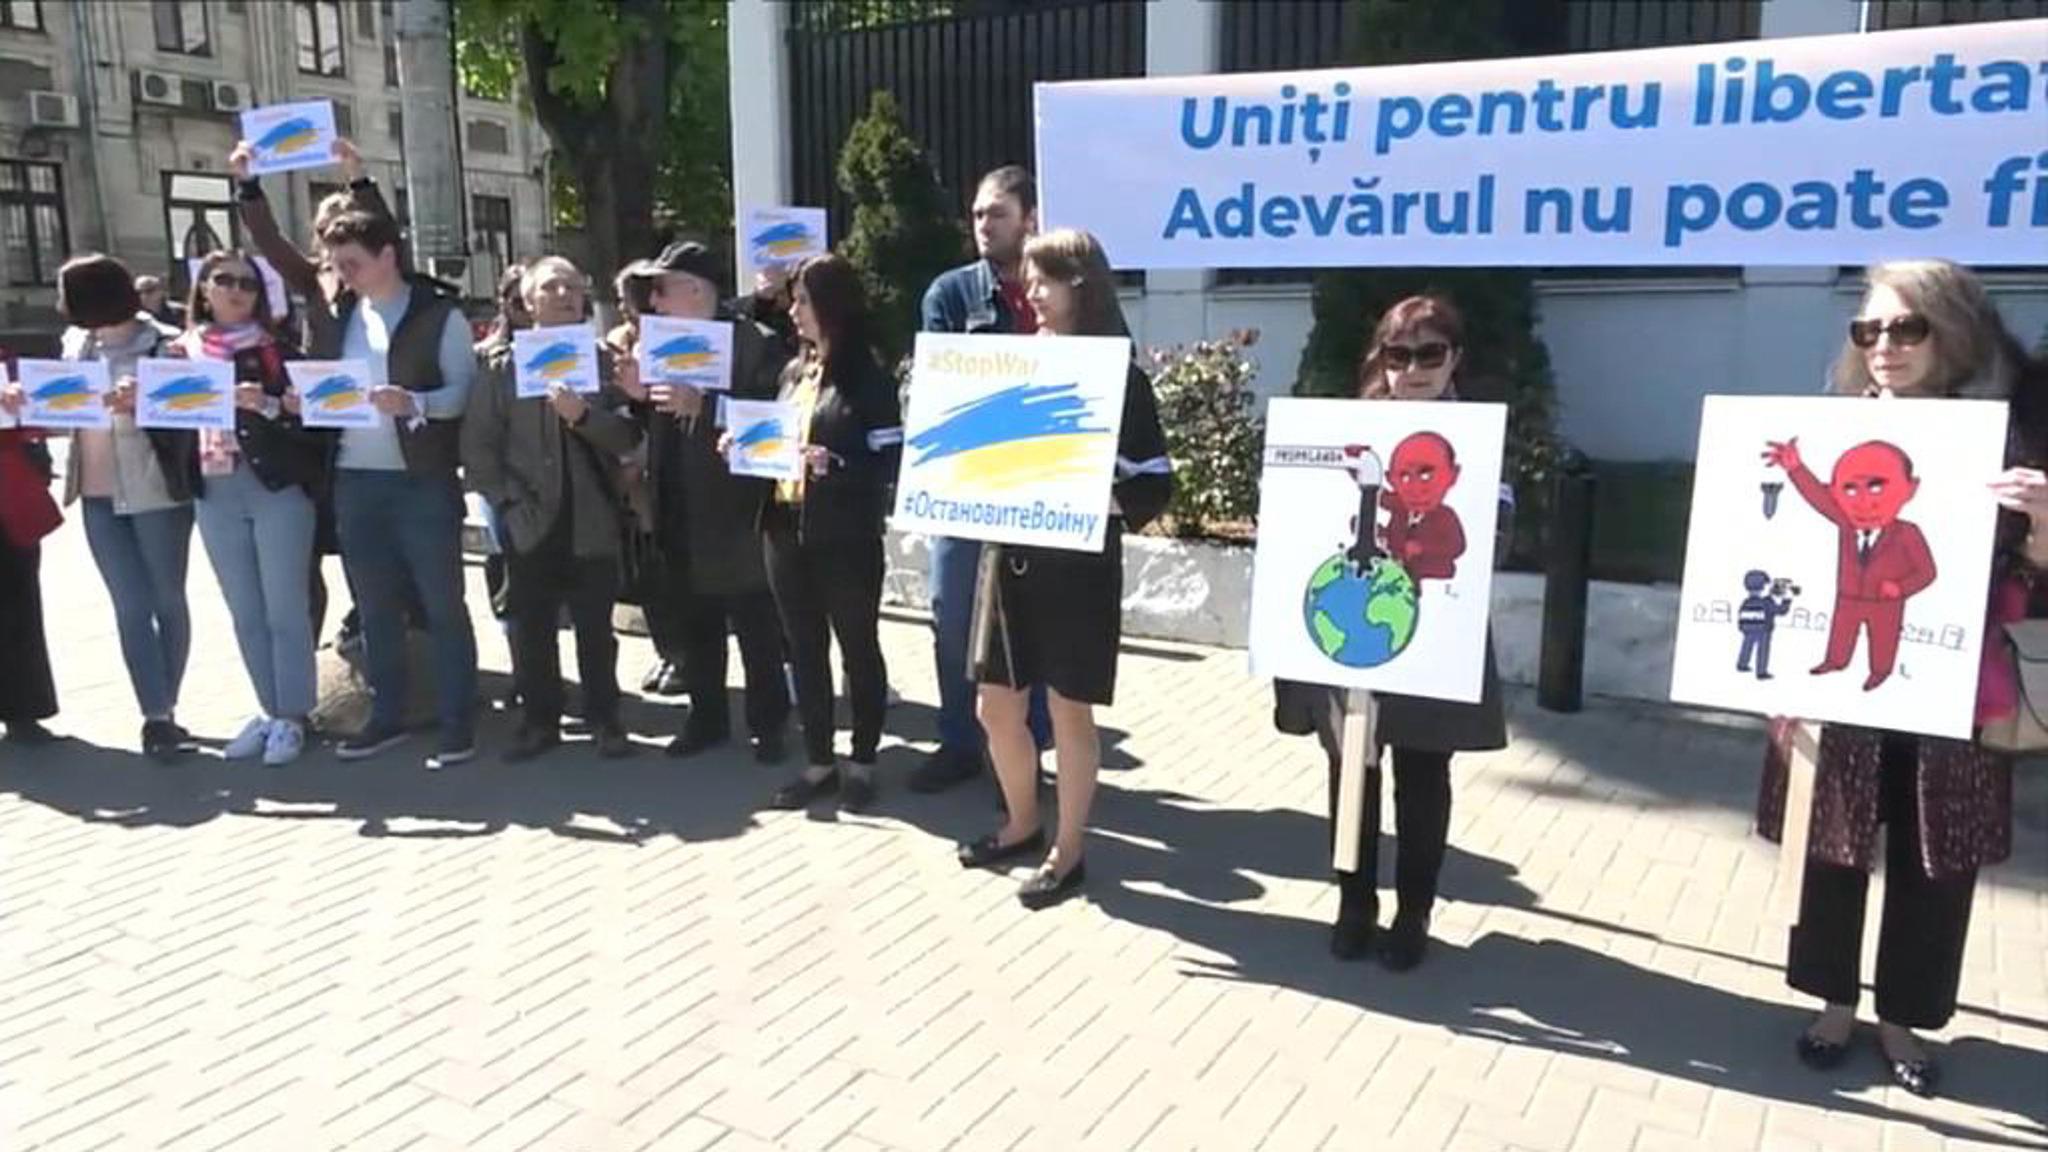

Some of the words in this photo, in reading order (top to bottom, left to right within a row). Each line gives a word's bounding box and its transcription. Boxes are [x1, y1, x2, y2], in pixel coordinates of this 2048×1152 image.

[1179, 84, 1352, 163] Uniți
[1373, 83, 1663, 157] pentru
[1161, 172, 1497, 241] Adevărul
[1522, 186, 1634, 237] nu
[1662, 167, 1953, 250] poate
[926, 349, 1041, 378] #StopWar
[905, 490, 1099, 542] #ОстановитеВойну
